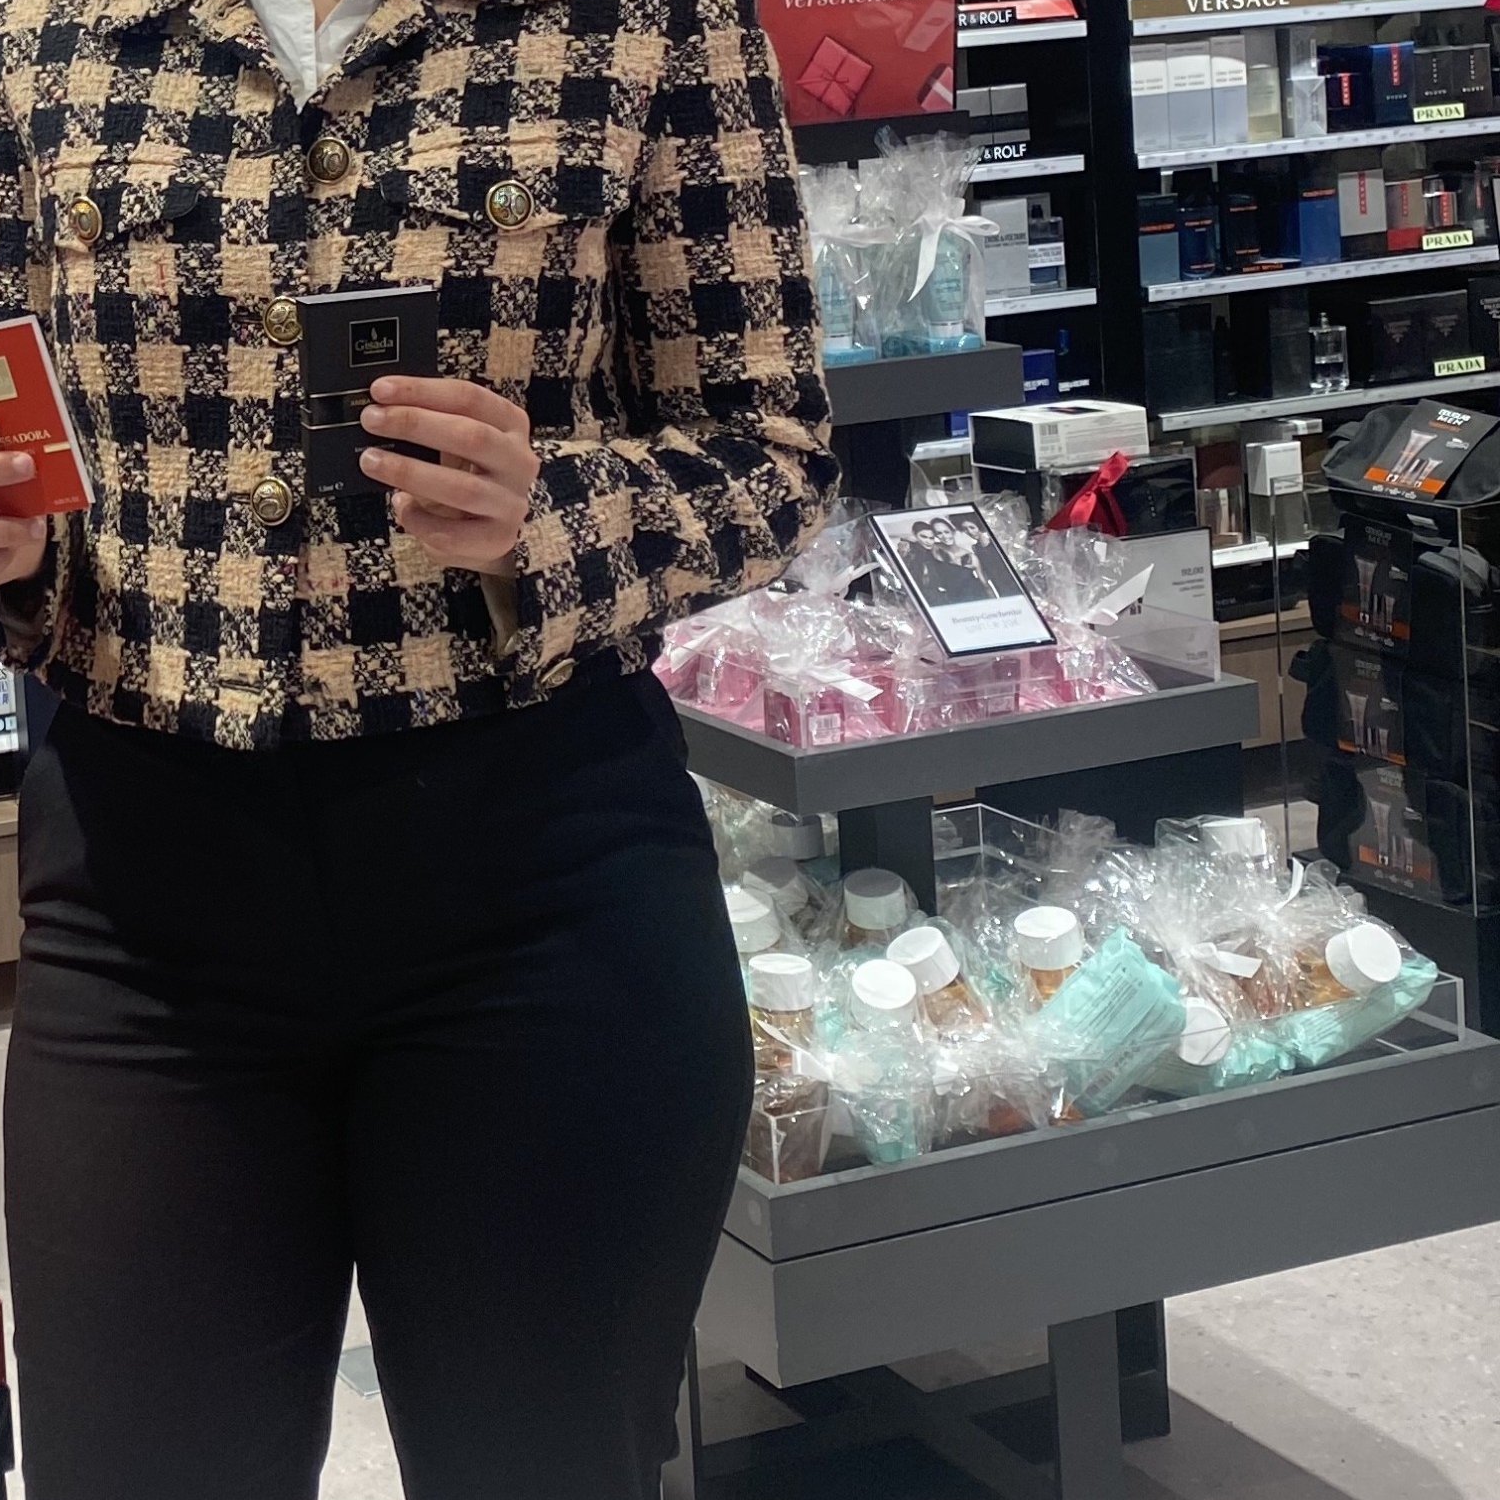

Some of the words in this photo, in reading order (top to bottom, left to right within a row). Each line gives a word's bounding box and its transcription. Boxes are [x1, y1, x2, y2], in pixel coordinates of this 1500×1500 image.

[979, 10, 1013, 26] ROLF
[1416, 106, 1462, 120] PRADA
[994, 144, 1028, 160] ROLF
[1425, 234, 1470, 247] PRADA
[355, 336, 394, 351] Gisada
[1437, 359, 1483, 374] PRADA
[1436, 416, 1464, 426] MEN
